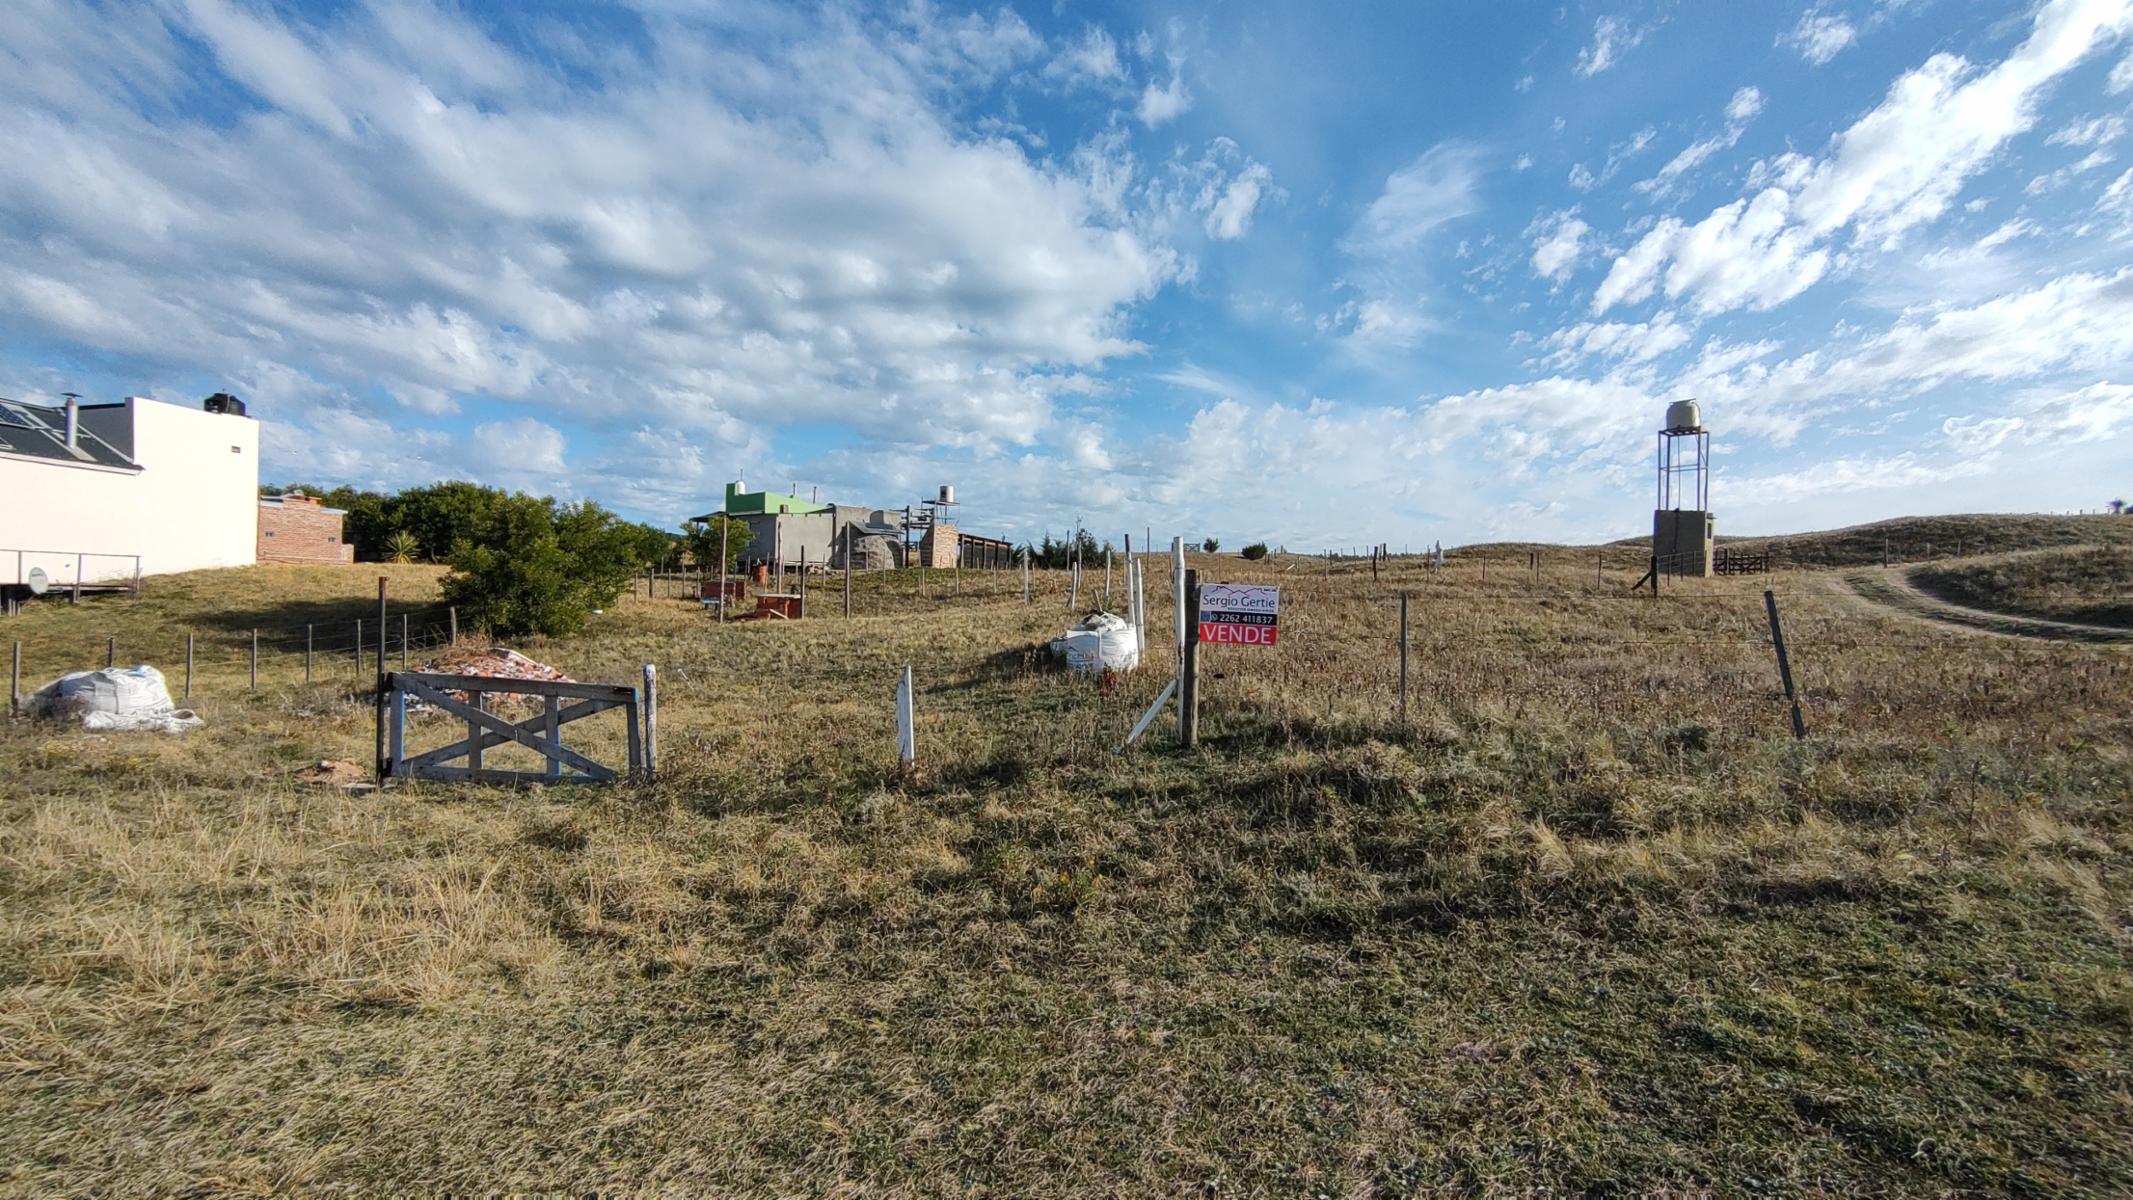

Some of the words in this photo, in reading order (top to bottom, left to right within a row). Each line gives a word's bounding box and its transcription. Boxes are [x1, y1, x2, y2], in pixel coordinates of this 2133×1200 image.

[1203, 595, 1238, 607] Sergio
[1241, 596, 1275, 608] Gertie
[1219, 614, 1240, 623] 2262
[1242, 615, 1273, 624] 411837
[1203, 625, 1272, 644] VENDE
